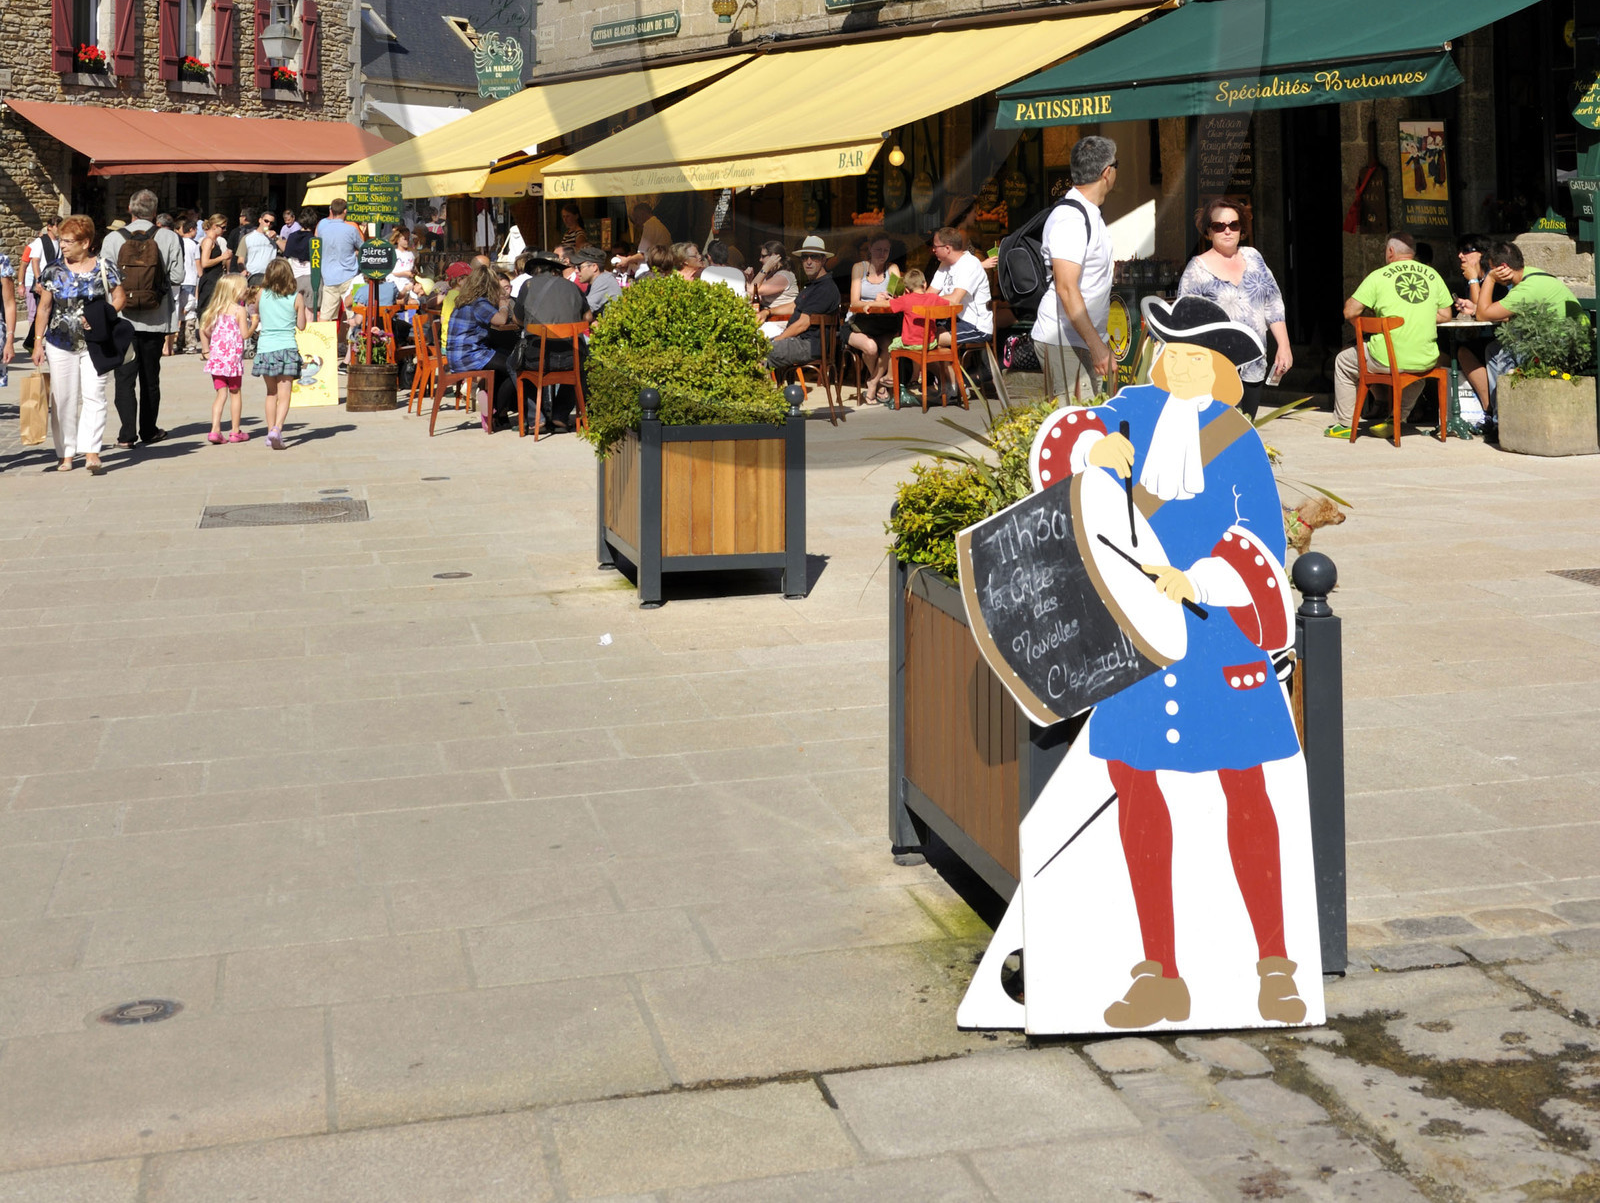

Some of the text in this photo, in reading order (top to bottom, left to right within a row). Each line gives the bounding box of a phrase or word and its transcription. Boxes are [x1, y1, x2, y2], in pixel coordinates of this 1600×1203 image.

[592, 27, 613, 40] ARTISAN
[654, 19, 662, 30] DE
[1215, 69, 1428, 107] Spécialités Bretonnes
[1014, 95, 1113, 122] PATISSERIE
[838, 150, 863, 169] BAR
[647, 171, 675, 185] Maison
[690, 167, 720, 185] Kouign
[721, 164, 755, 180] Amann
[311, 239, 320, 268] BAR
[362, 247, 387, 256] Bières
[1012, 619, 1080, 665] Nouvelles
